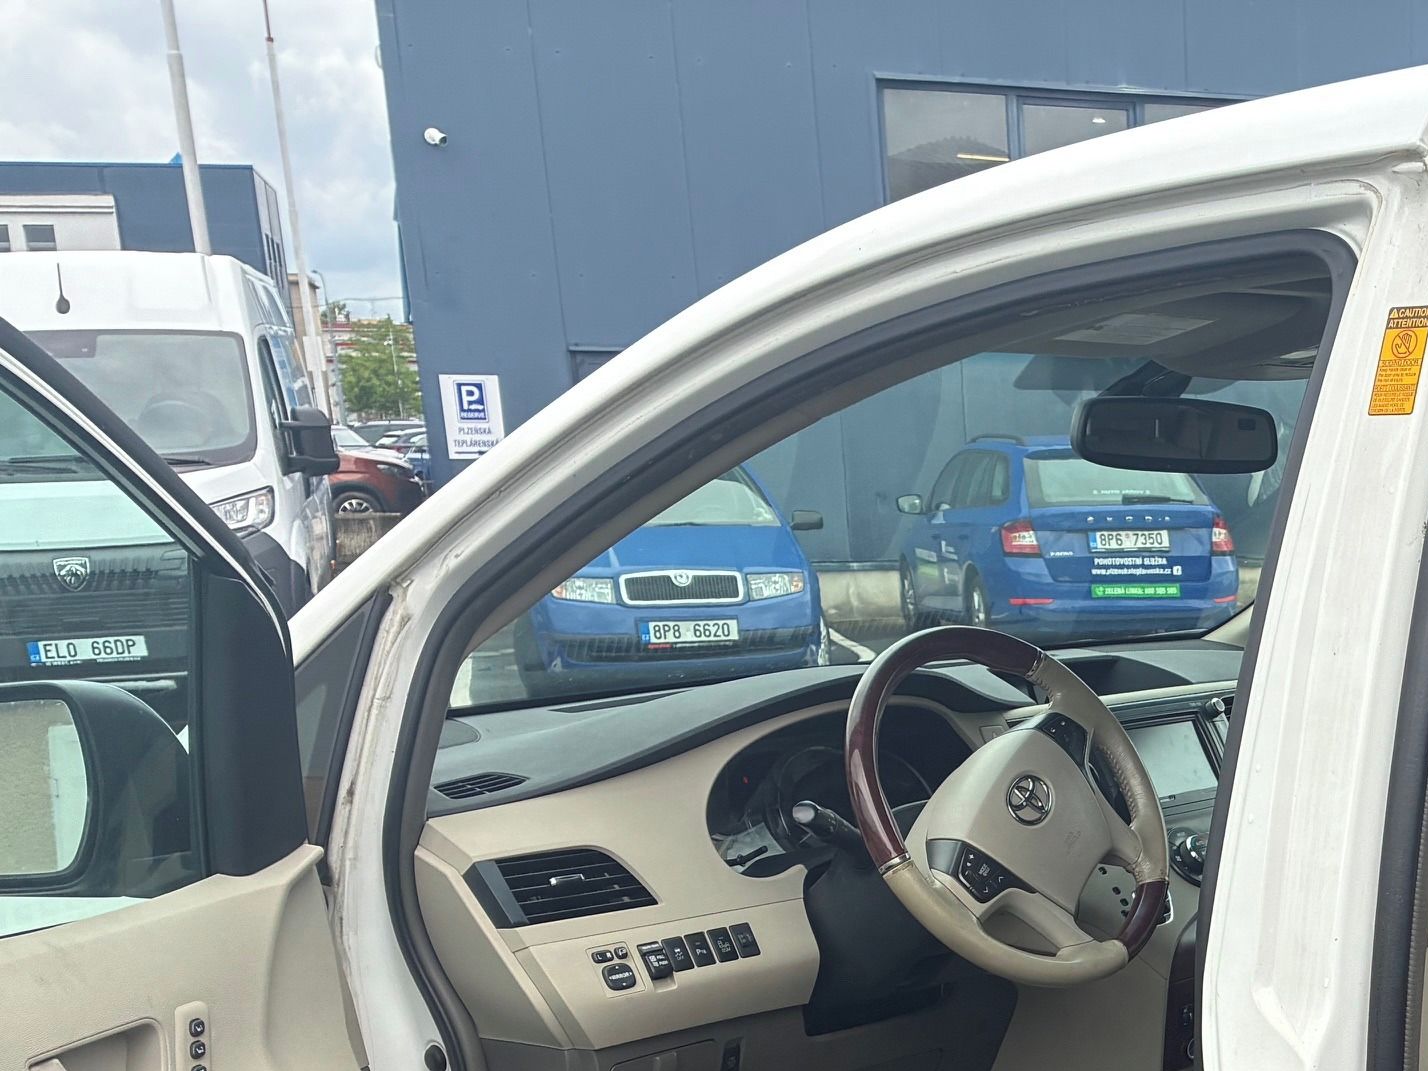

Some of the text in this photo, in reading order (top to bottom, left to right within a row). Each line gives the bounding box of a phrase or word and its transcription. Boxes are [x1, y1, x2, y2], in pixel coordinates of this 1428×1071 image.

[460, 385, 480, 410] P
[1099, 532, 1163, 547] 8P6 7350
[652, 622, 731, 640] 8P8 6620
[91, 638, 136, 656] 66DP
